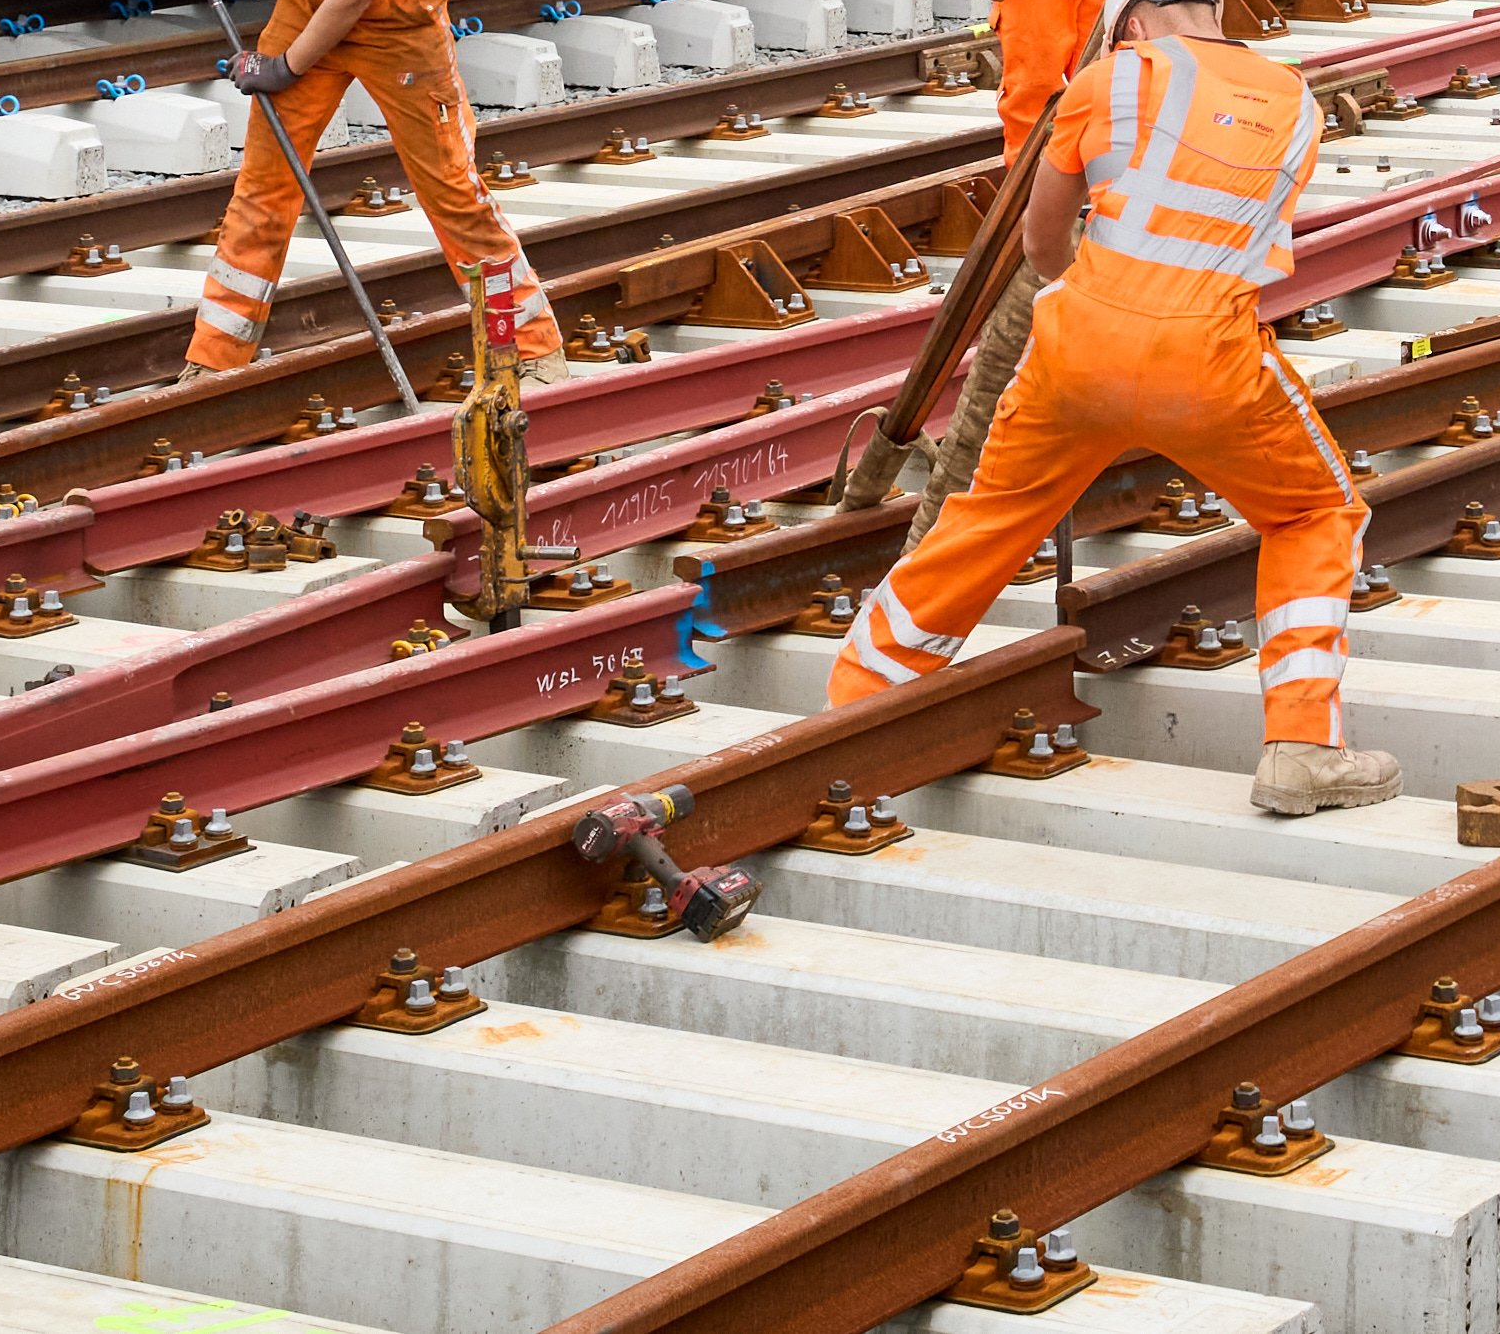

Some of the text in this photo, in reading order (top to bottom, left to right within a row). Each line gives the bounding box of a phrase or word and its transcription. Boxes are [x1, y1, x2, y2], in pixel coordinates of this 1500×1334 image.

[1237, 117, 1253, 127] van
[537, 667, 581, 694] WSL
[581, 826, 600, 851] FUEL
